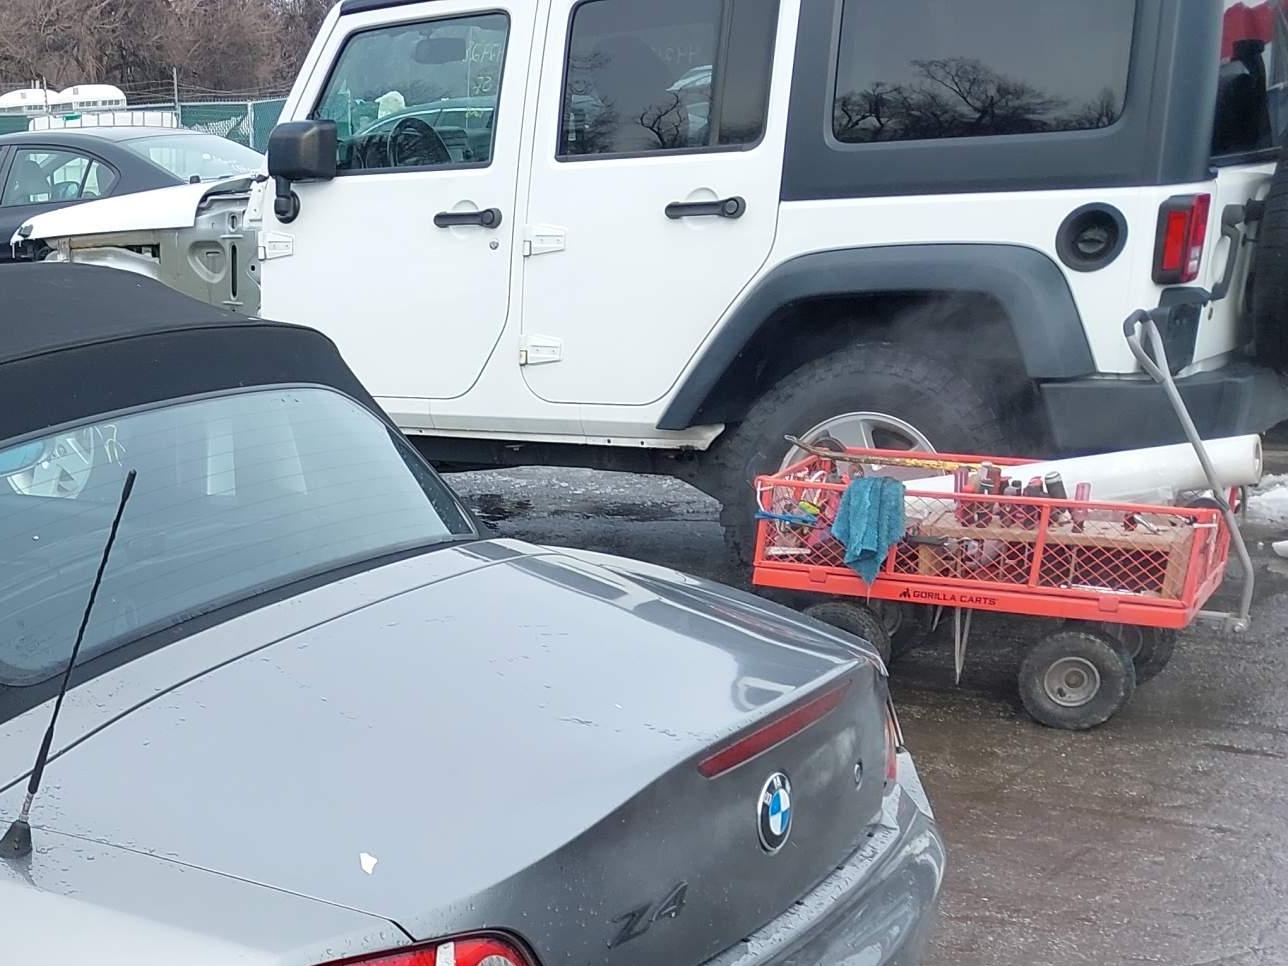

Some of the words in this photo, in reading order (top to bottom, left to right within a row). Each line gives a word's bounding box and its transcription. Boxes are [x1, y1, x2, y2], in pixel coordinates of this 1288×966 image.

[912, 590, 957, 602] GORILLA
[959, 595, 997, 606] CARTS
[612, 881, 688, 947] Z4
